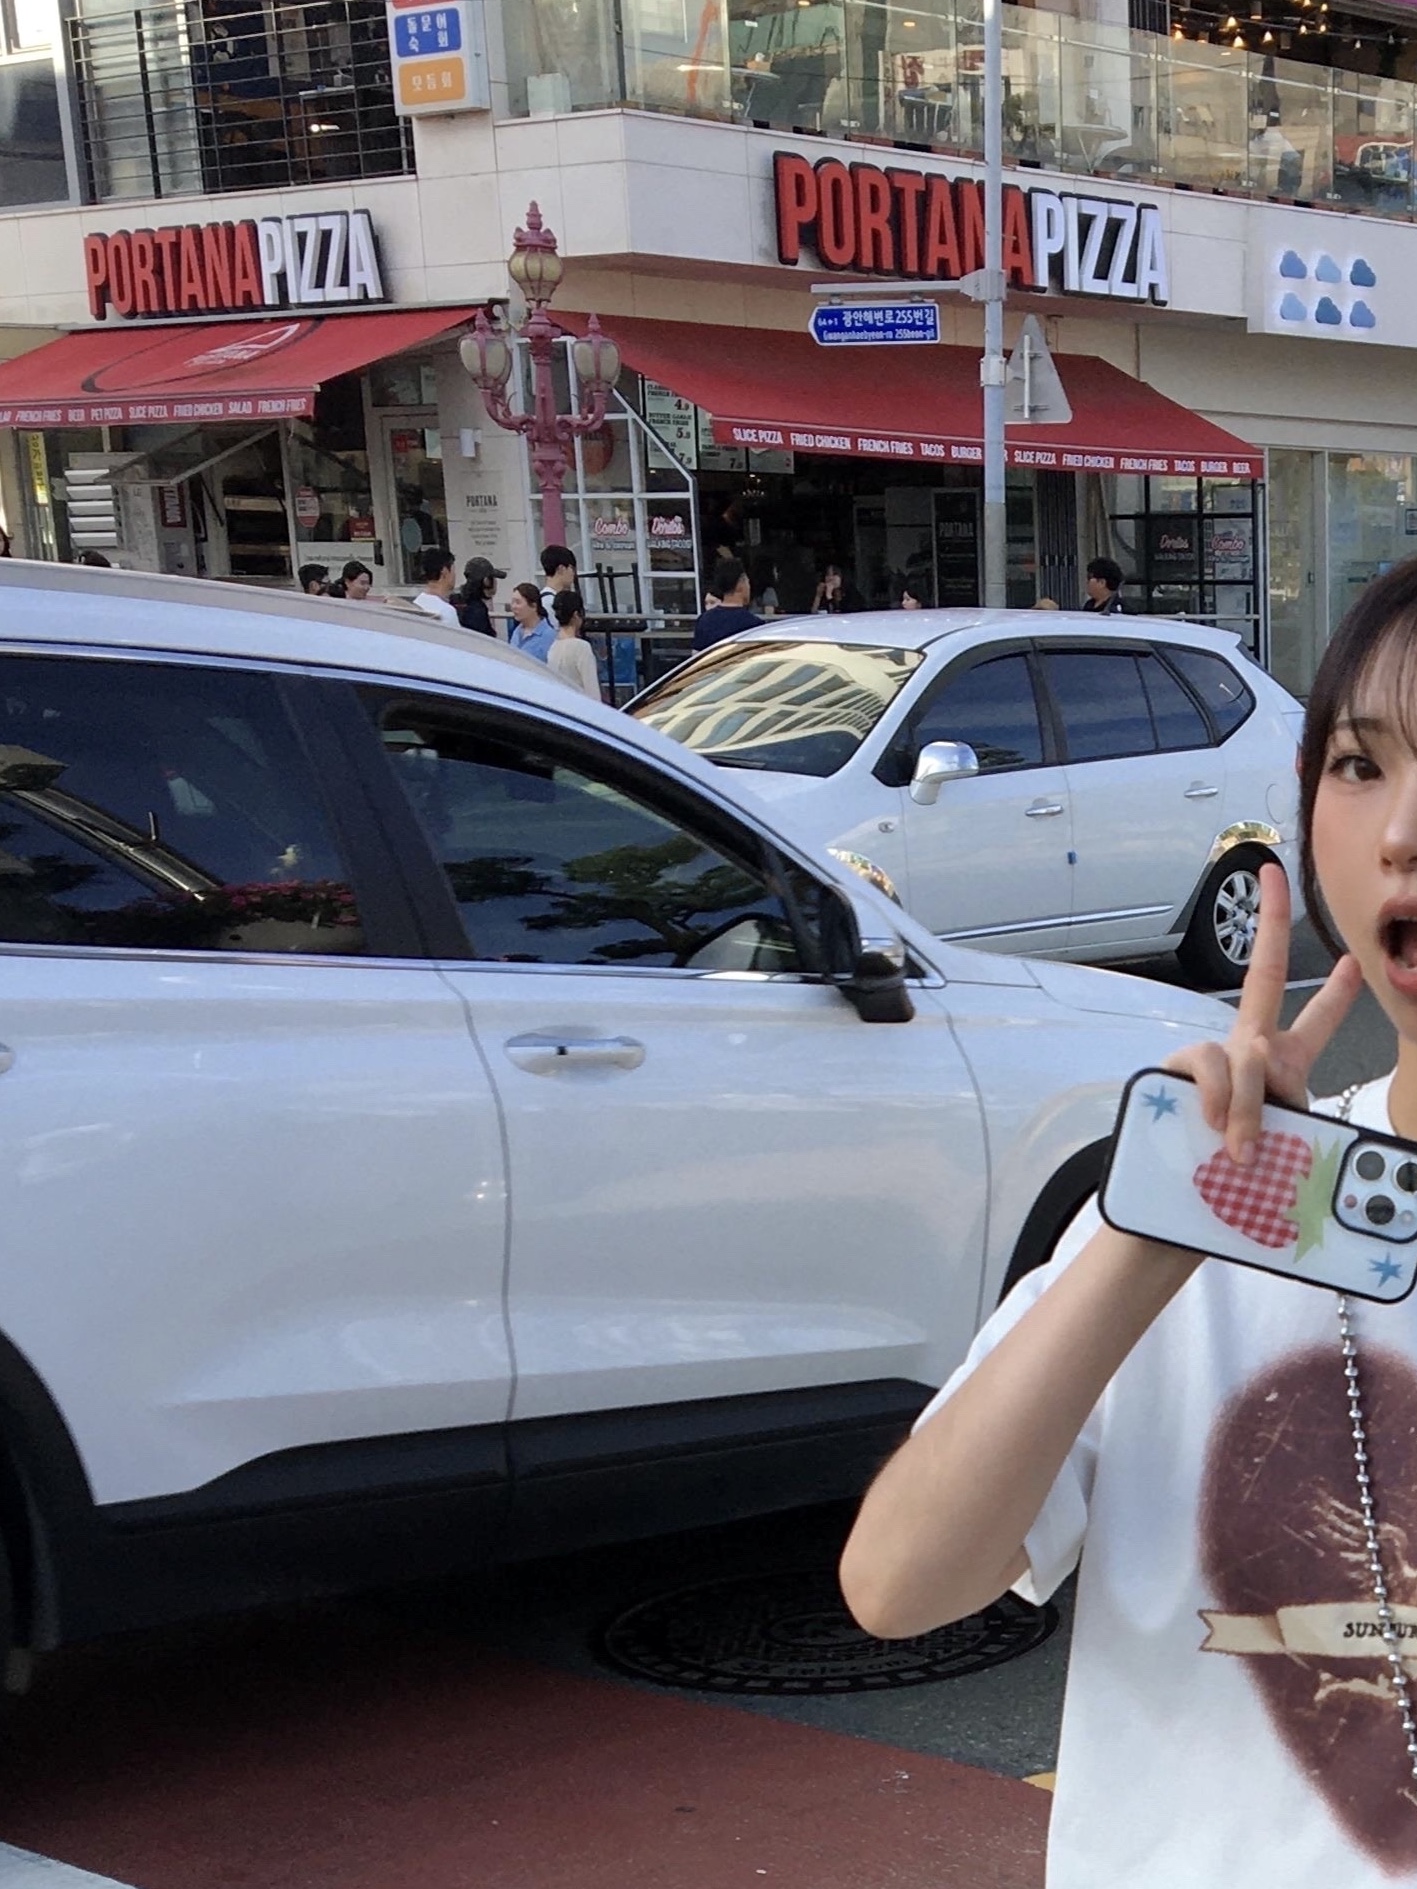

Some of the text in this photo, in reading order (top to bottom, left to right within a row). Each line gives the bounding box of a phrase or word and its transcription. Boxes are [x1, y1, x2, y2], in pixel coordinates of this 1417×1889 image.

[732, 427, 758, 444] SLICE
[759, 429, 784, 445] PIZZA
[790, 432, 815, 447] FRIED
[815, 434, 851, 451] CHICKEN
[858, 437, 890, 453] FRENCH
[890, 439, 913, 456] FRIES
[920, 442, 945, 457] TACOS
[951, 444, 982, 460] BURGER
[594, 517, 629, 536] Combo
